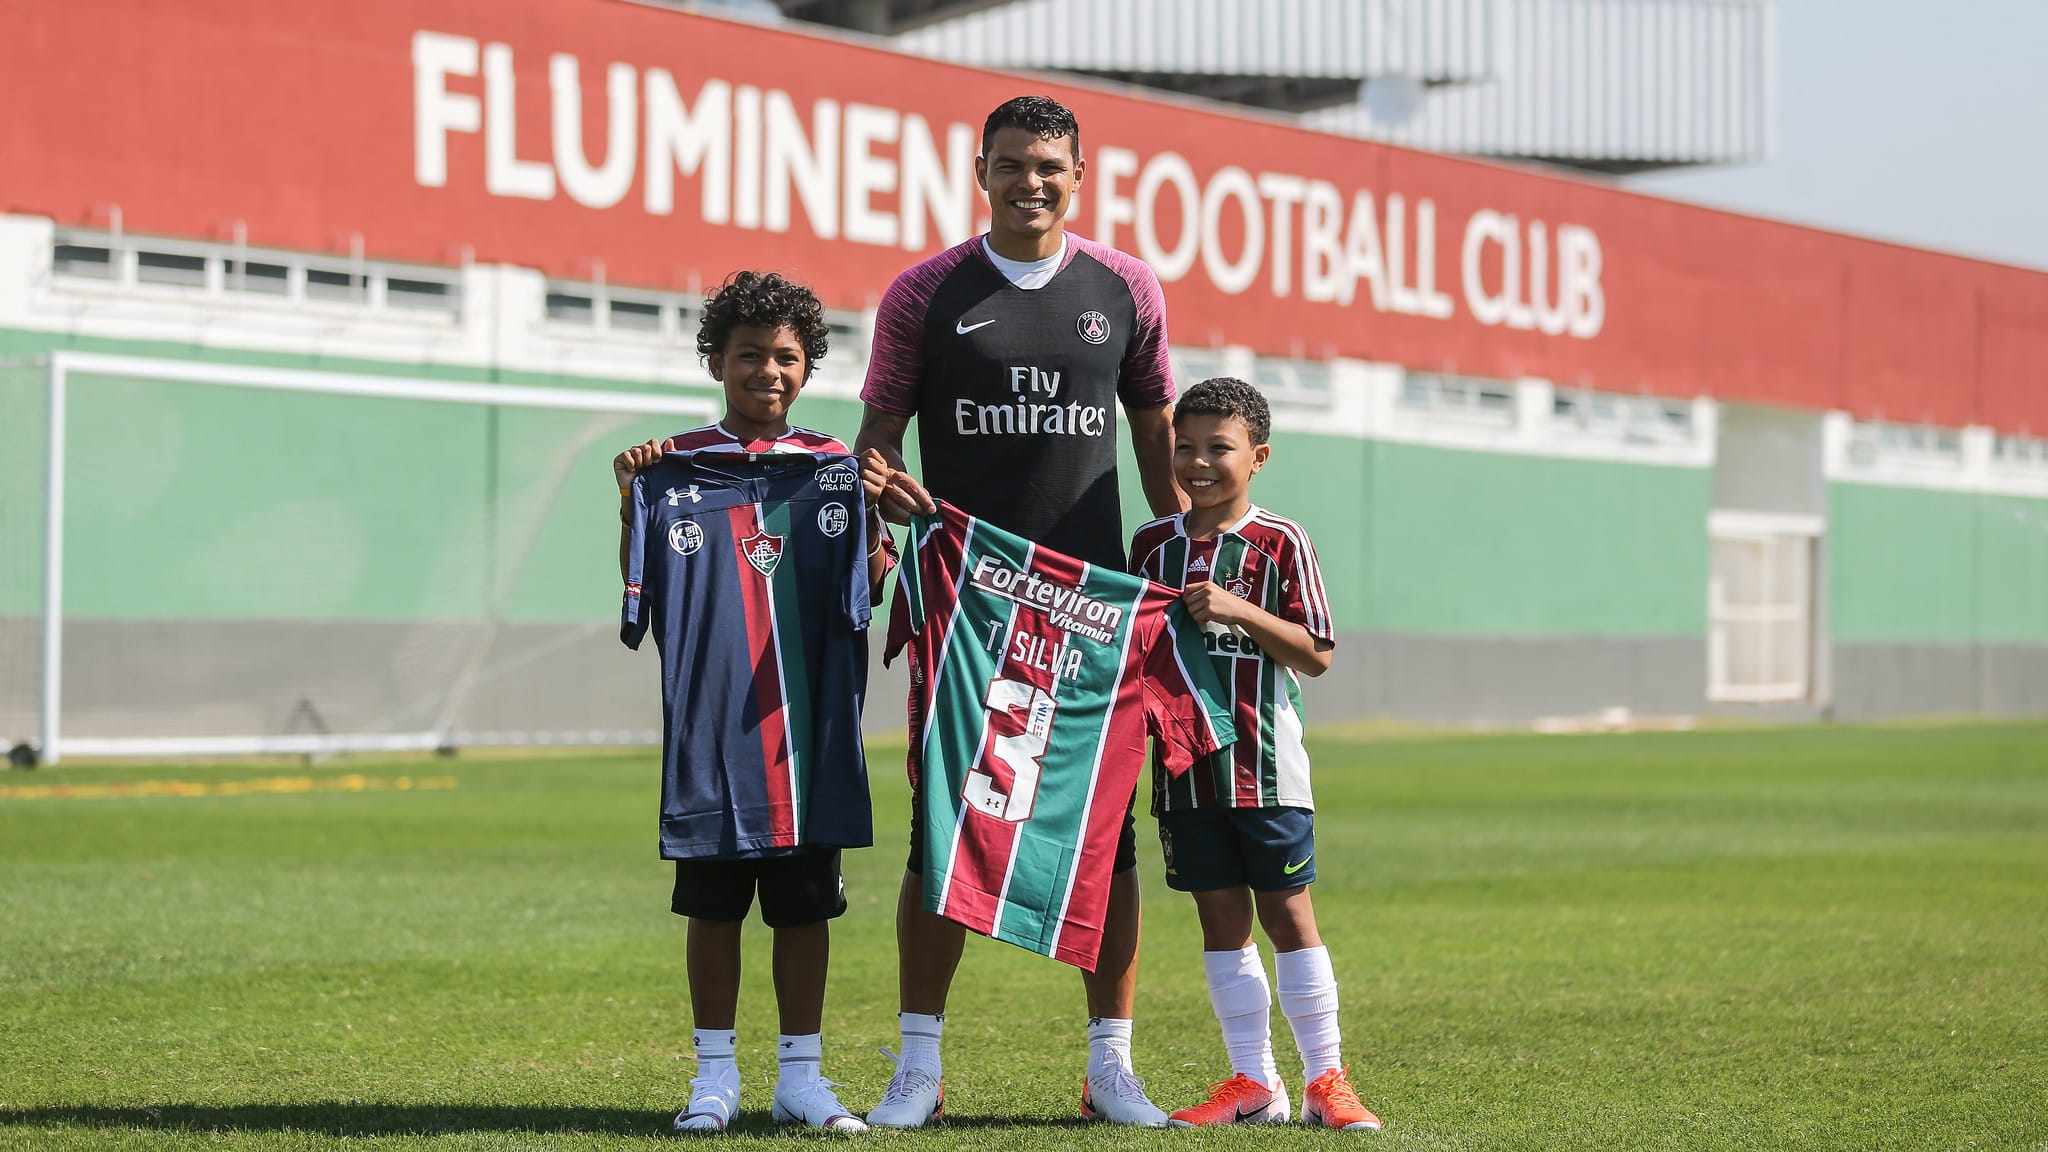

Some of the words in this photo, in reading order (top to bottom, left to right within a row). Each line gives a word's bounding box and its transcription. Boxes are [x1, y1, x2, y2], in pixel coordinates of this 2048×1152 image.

[412, 30, 1080, 252] FLUMINEN
[1098, 146, 1453, 318] FOOTBALL
[1460, 208, 1606, 340] CLUB
[1009, 366, 1061, 398] Fly
[956, 395, 1106, 437] Emirates
[819, 483, 838, 491] VISA
[840, 483, 853, 491] RIO
[820, 473, 854, 484] AUTO
[972, 554, 1123, 629] Forteviron
[1049, 609, 1113, 644] Vitamin
[986, 620, 1004, 655] T.
[1011, 631, 1083, 681] SILVA
[1035, 702, 1048, 725] TIM
[960, 677, 1060, 823] 3
